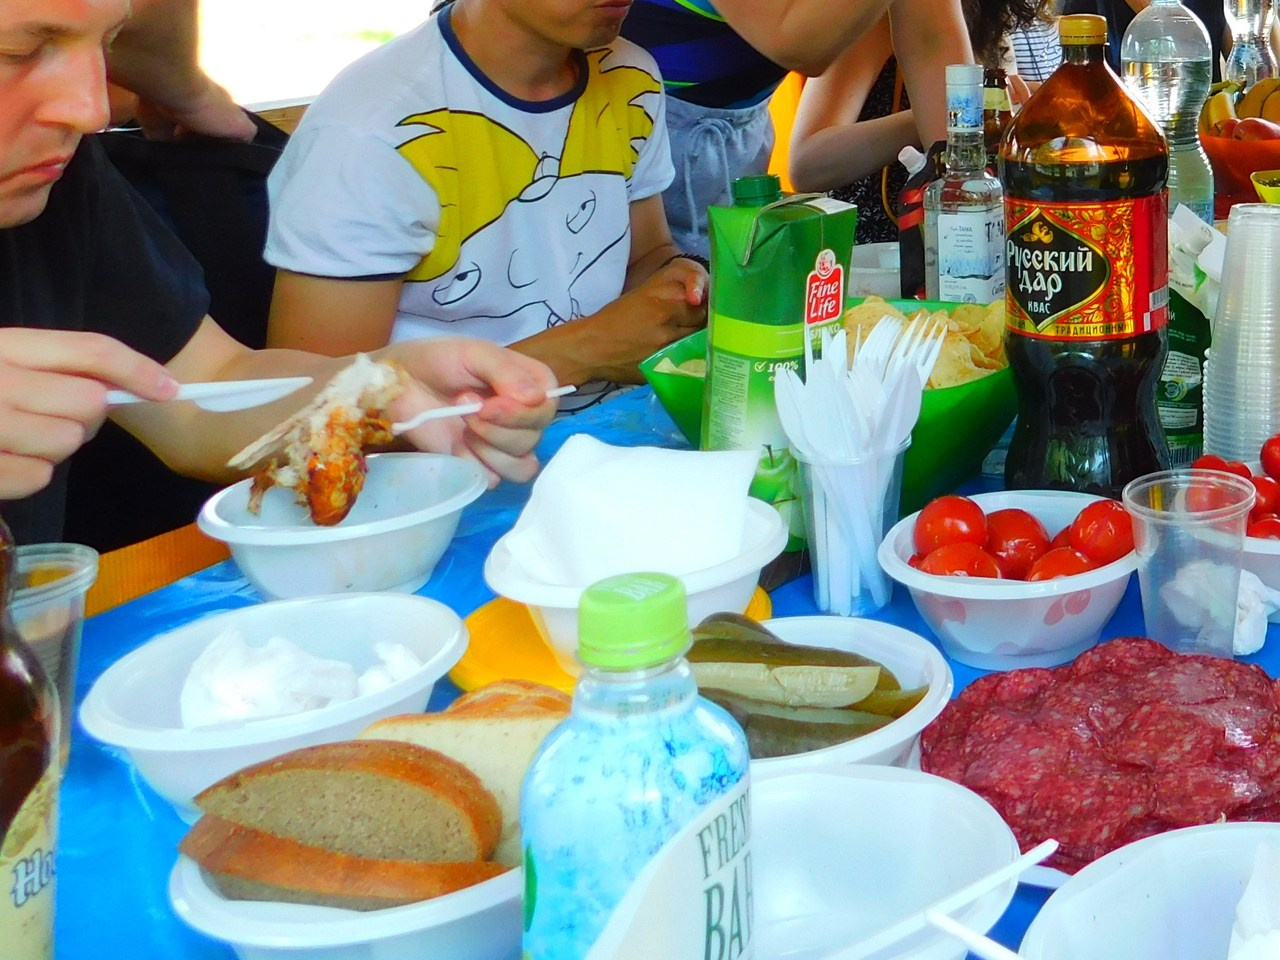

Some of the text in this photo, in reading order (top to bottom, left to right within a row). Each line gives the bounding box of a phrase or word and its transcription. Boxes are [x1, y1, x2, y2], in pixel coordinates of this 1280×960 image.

[1006, 239, 1093, 278] Русский
[810, 280, 839, 303] Fine
[810, 297, 836, 319] Life
[1027, 300, 1051, 314] КВАС
[697, 786, 750, 880] FRES
